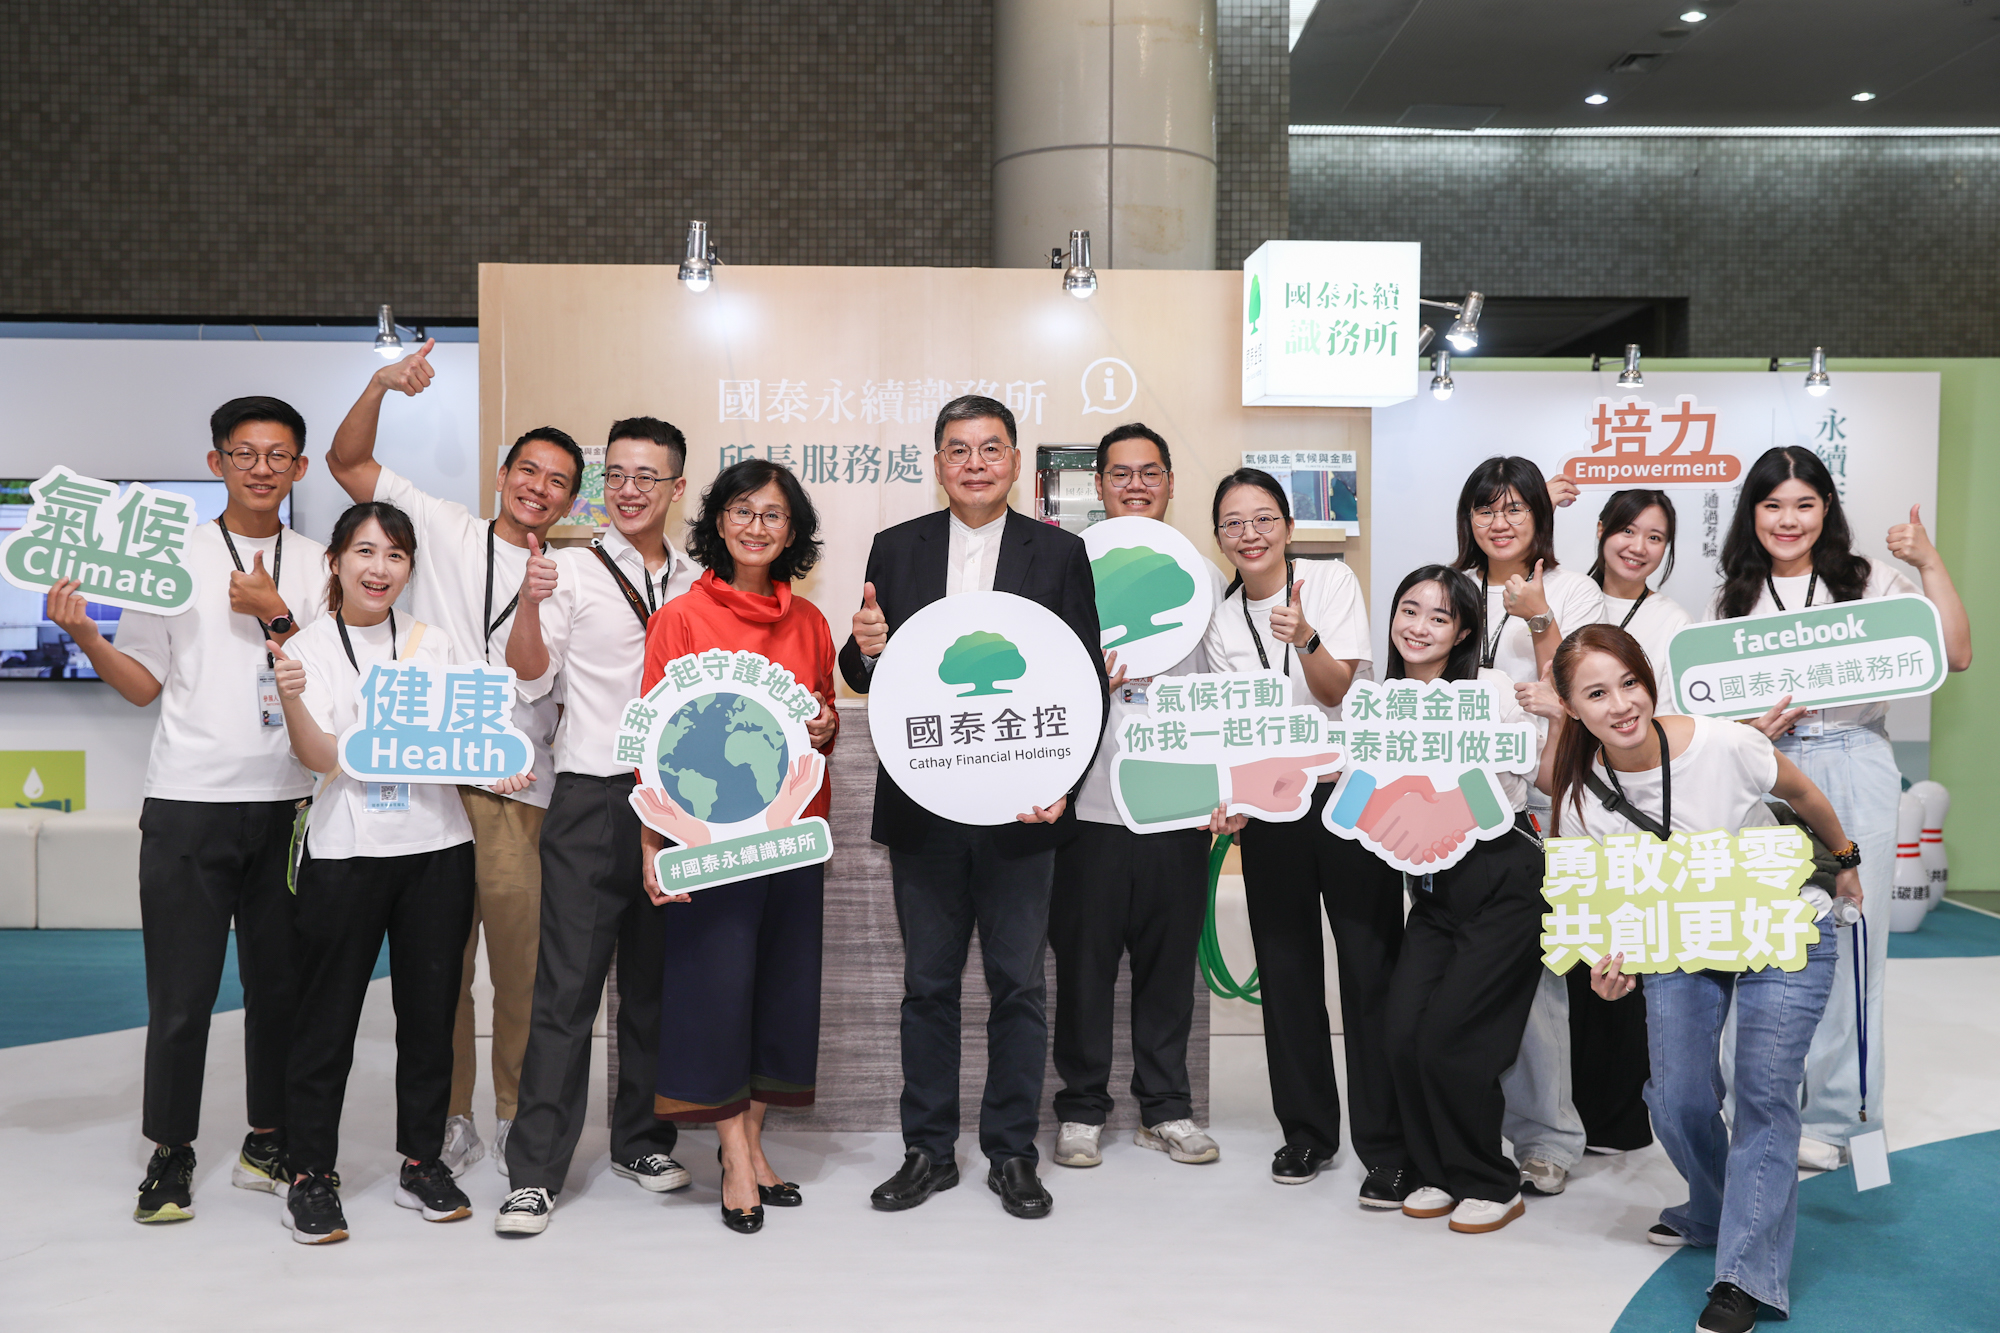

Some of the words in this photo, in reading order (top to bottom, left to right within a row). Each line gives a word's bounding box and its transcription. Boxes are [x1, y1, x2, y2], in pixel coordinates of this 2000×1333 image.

[1285, 281, 1400, 311] 國泰永續
[1285, 319, 1399, 357] 識務所
[1590, 401, 1717, 457] 培力
[1295, 453, 1353, 464] 氣候與金融
[1574, 460, 1727, 480] Empowerment
[1815, 408, 1847, 504] 永續
[31, 473, 190, 566] 氣候
[23, 545, 178, 601] Climate
[1733, 613, 1867, 655] facebook
[1155, 677, 1284, 714] 氣候行動
[1719, 650, 1924, 702] 國泰永續識務所
[361, 664, 509, 734] 健康
[617, 653, 816, 764] 跟我一起守護地球
[1350, 688, 1491, 721] 永續金融
[905, 704, 1069, 749] 國泰金控
[1124, 714, 1319, 753] 你我一起行動
[1328, 729, 1527, 764] 泰說到做到
[371, 738, 506, 774] Health
[909, 756, 952, 769] Cathay
[956, 750, 1011, 766] Financial
[1015, 747, 1071, 761] Holdings
[670, 832, 816, 880] #國泰永續識務所
[1544, 828, 1805, 898] 勇敢淨零
[1543, 897, 1809, 965] 共創更好
